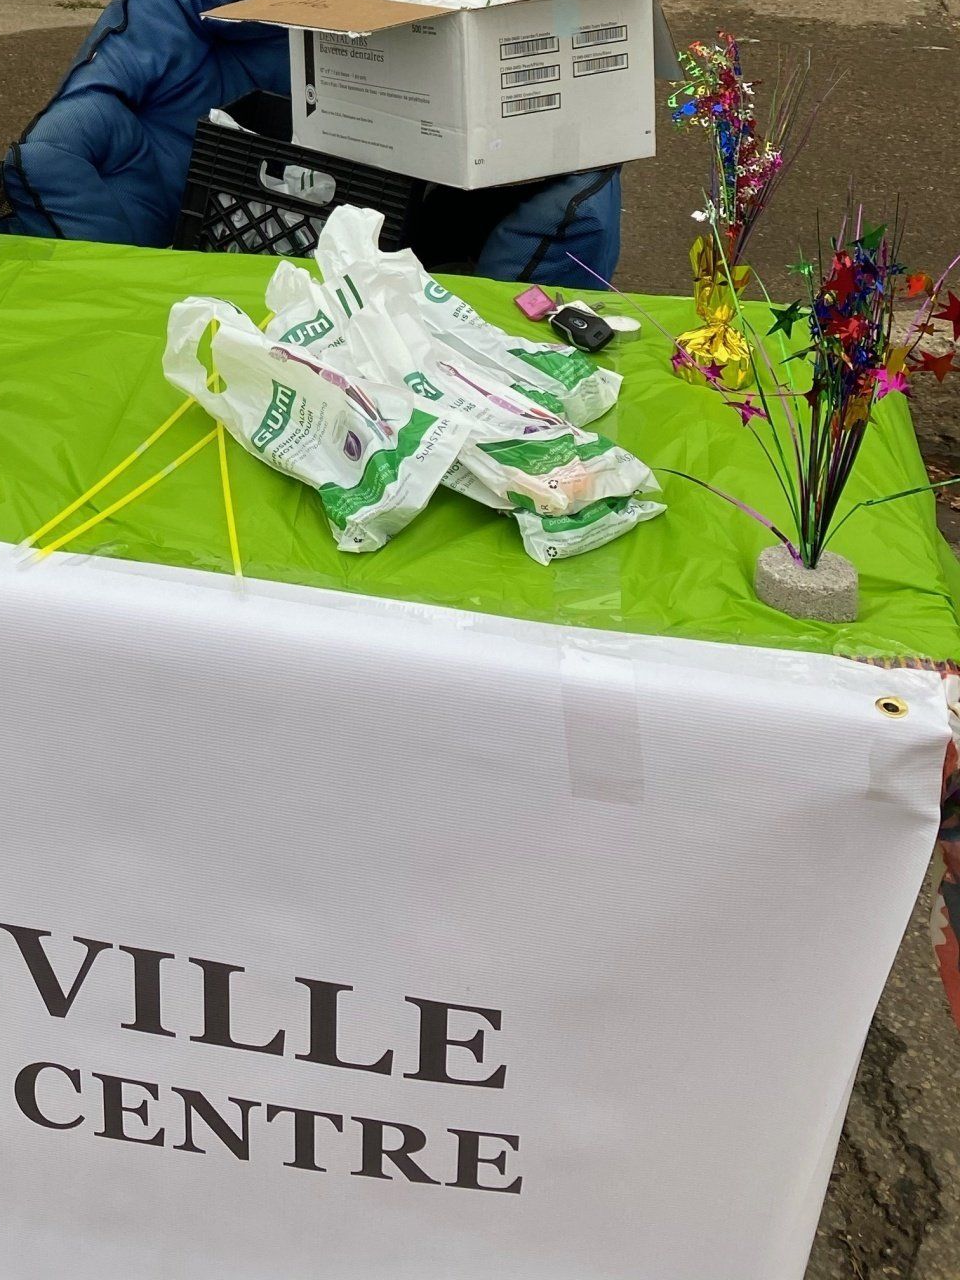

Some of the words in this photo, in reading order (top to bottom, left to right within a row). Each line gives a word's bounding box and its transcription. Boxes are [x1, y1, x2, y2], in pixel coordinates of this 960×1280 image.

[411, 24, 422, 34] 500
[319, 32, 350, 45] DENTAL
[351, 36, 369, 47] BIBS
[319, 43, 349, 57] Bavettes
[349, 47, 385, 63] dentaires
[278, 443, 294, 460] NOT
[294, 410, 314, 445] ENOUGH
[13, 1061, 525, 1196] CENTRE
